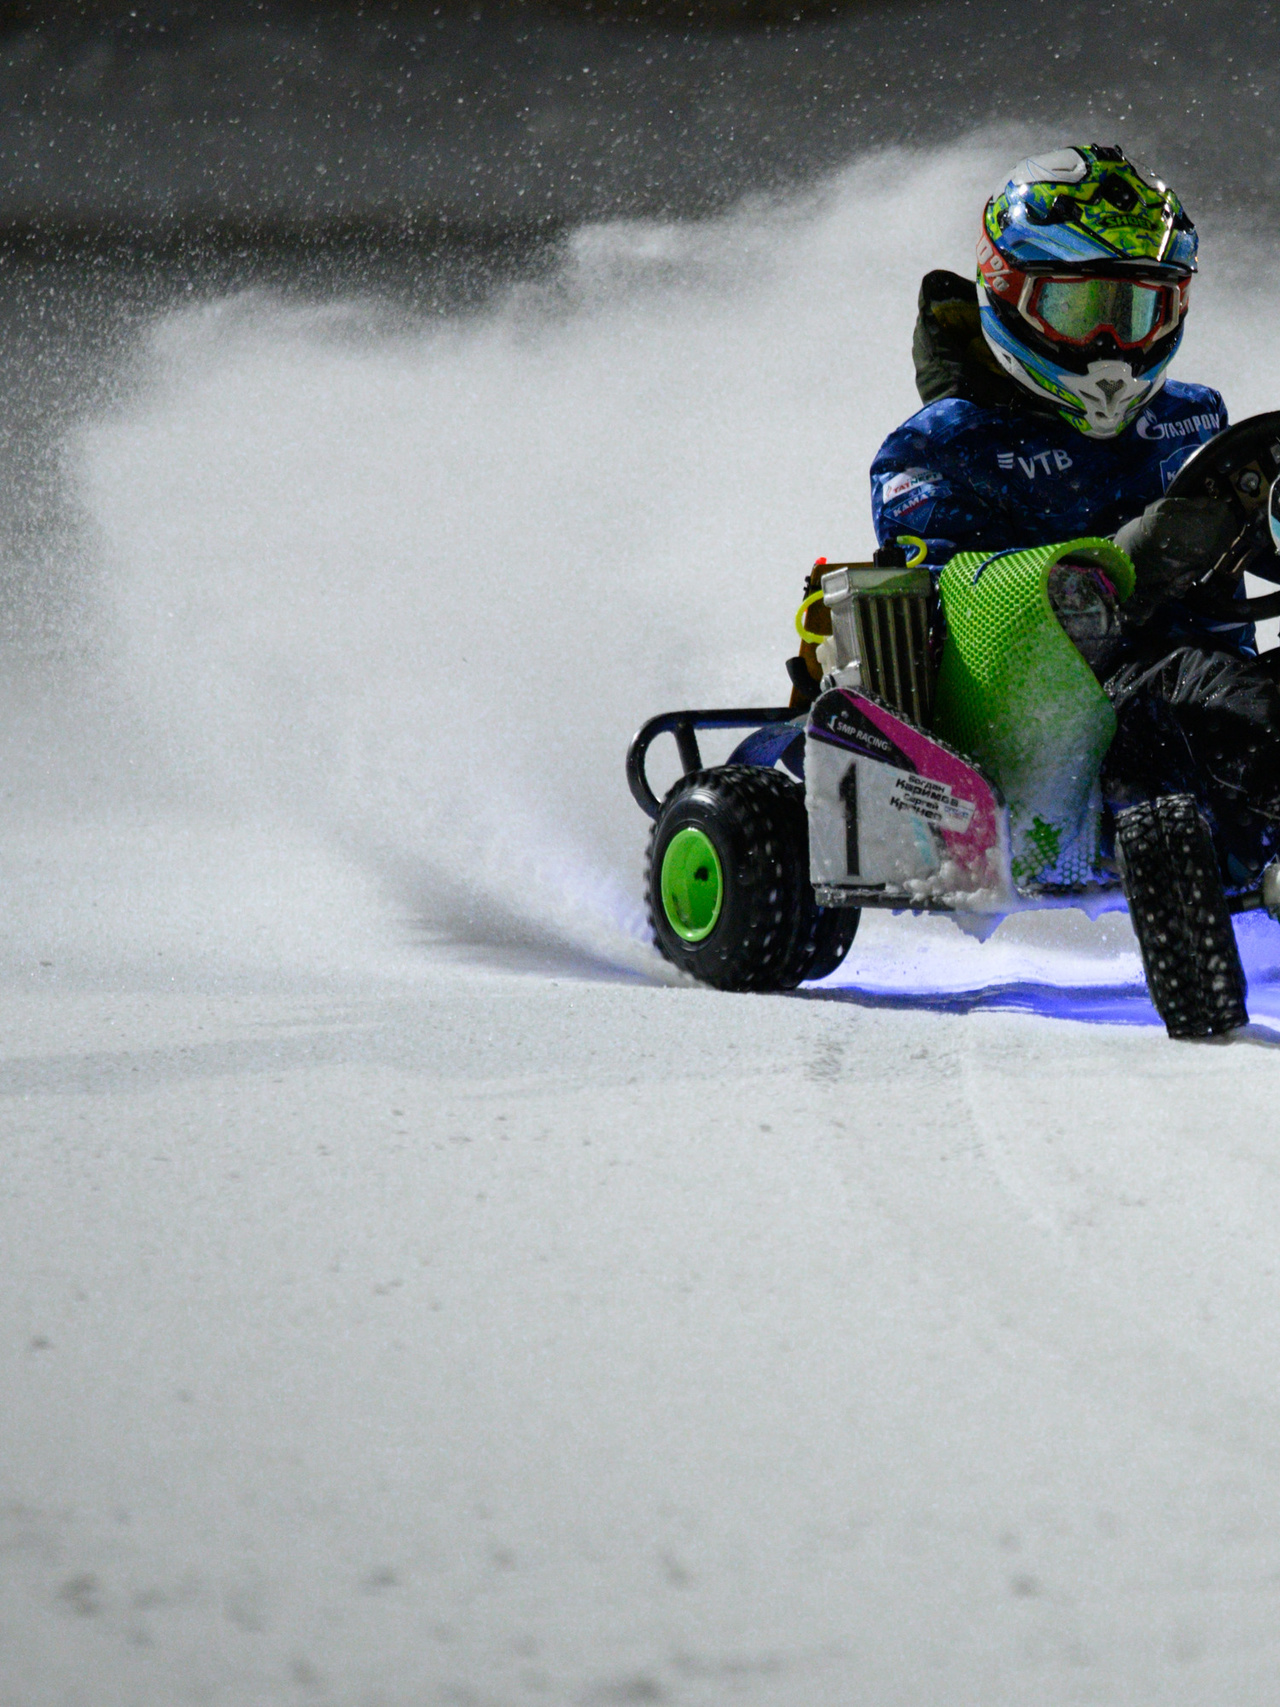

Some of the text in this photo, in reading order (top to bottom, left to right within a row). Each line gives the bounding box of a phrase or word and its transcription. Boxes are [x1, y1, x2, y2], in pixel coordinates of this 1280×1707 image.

[1105, 214, 1152, 230] SHOEI
[1017, 449, 1074, 480] VTB
[836, 721, 889, 751] SMP RACING
[908, 774, 945, 793] Богдан
[838, 761, 860, 877] 1
